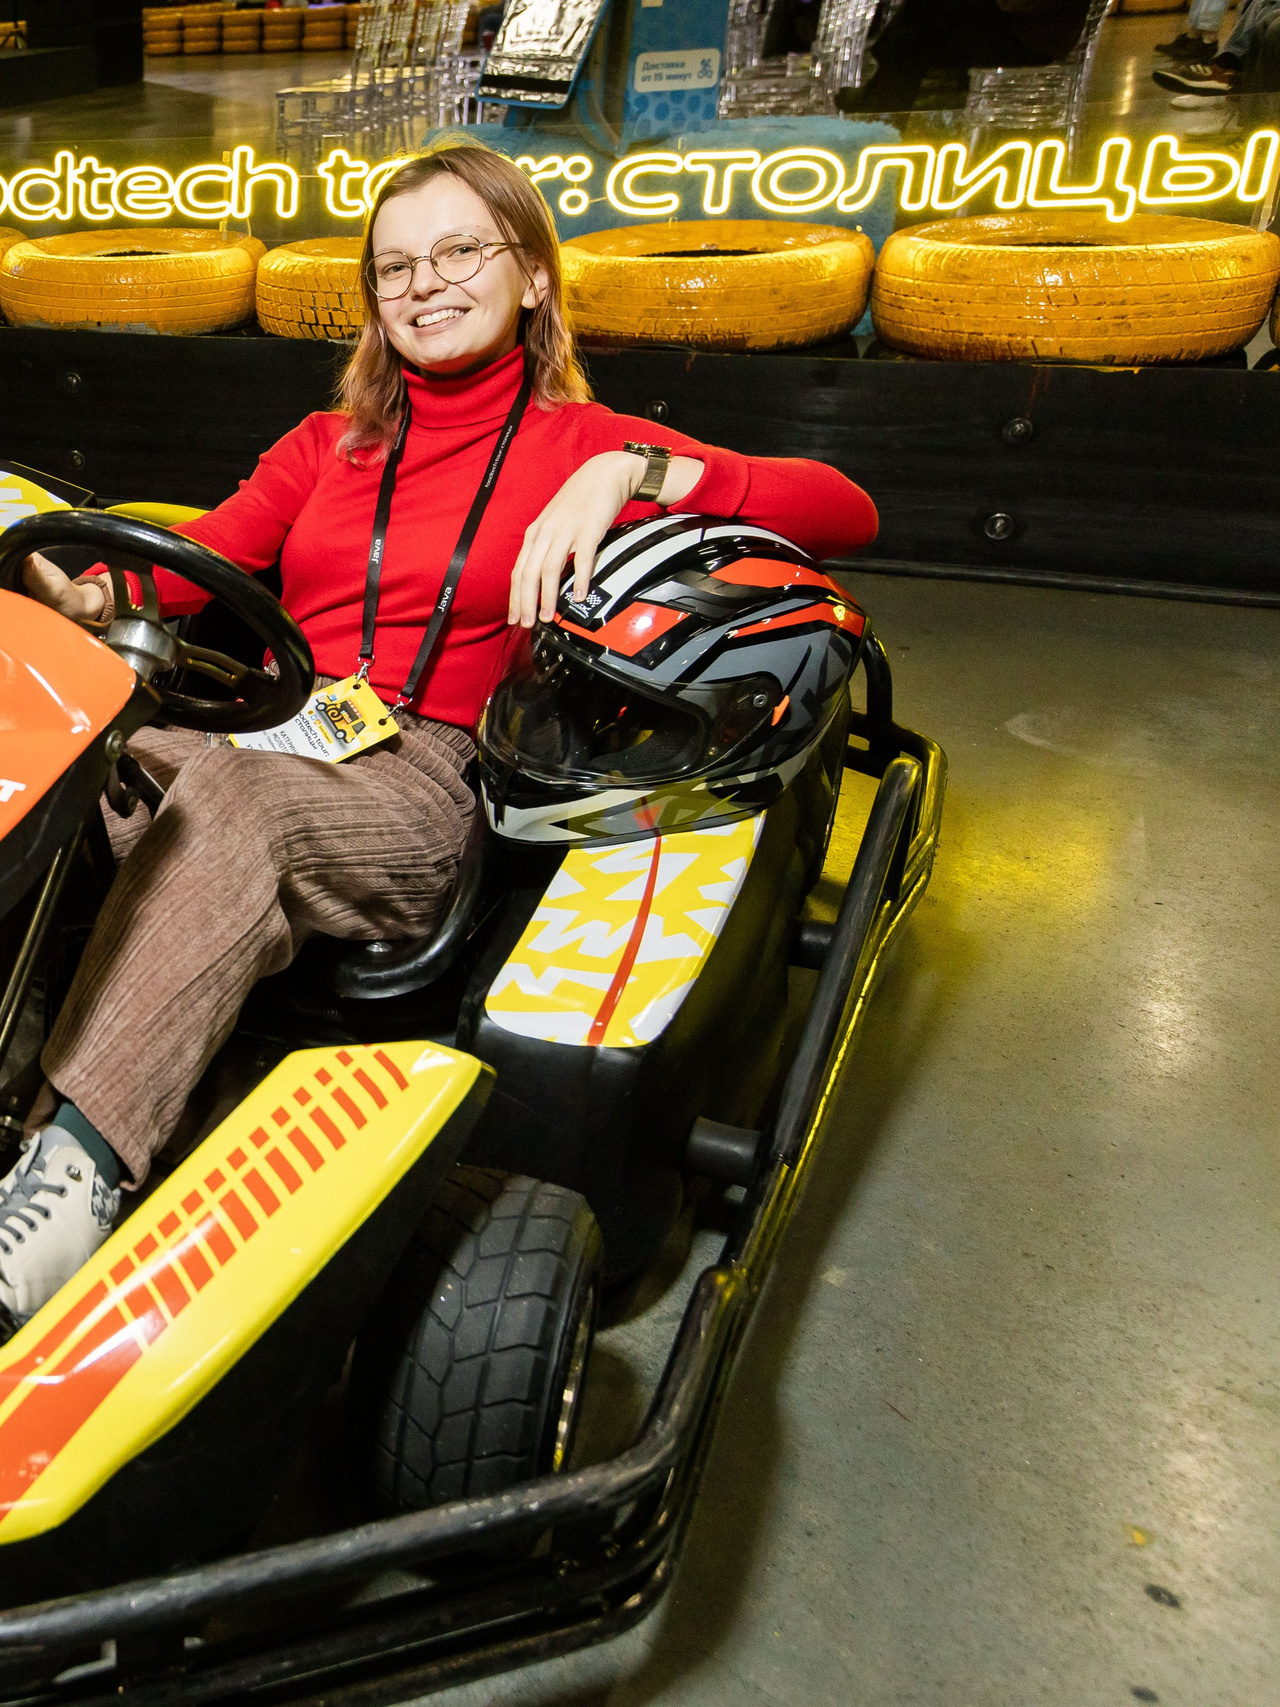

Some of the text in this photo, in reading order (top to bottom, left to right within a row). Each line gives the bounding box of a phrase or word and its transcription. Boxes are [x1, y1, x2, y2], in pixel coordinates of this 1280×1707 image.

[317, 149, 593, 218] tr:
[371, 538, 382, 564] Java
[438, 586, 453, 612] Java
[299, 712, 318, 739] odtech
[272, 732, 290, 755] МОЛОТО
